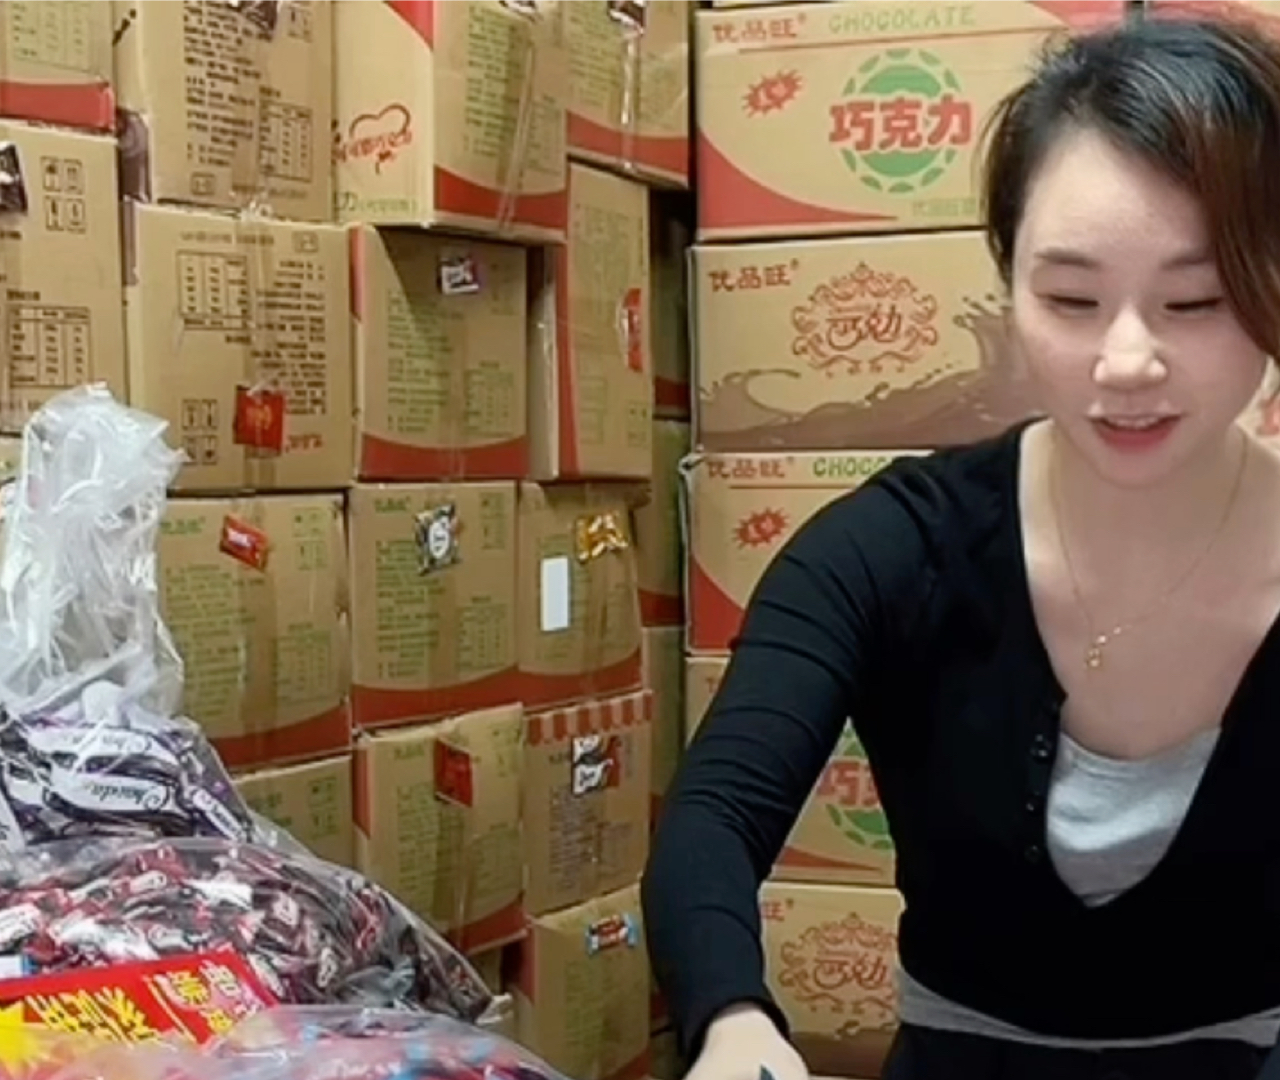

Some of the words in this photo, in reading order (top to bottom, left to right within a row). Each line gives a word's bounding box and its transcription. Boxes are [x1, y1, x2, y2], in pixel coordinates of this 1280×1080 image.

[829, 7, 976, 34] CHOCOLATE
[829, 95, 973, 152] 巧克力
